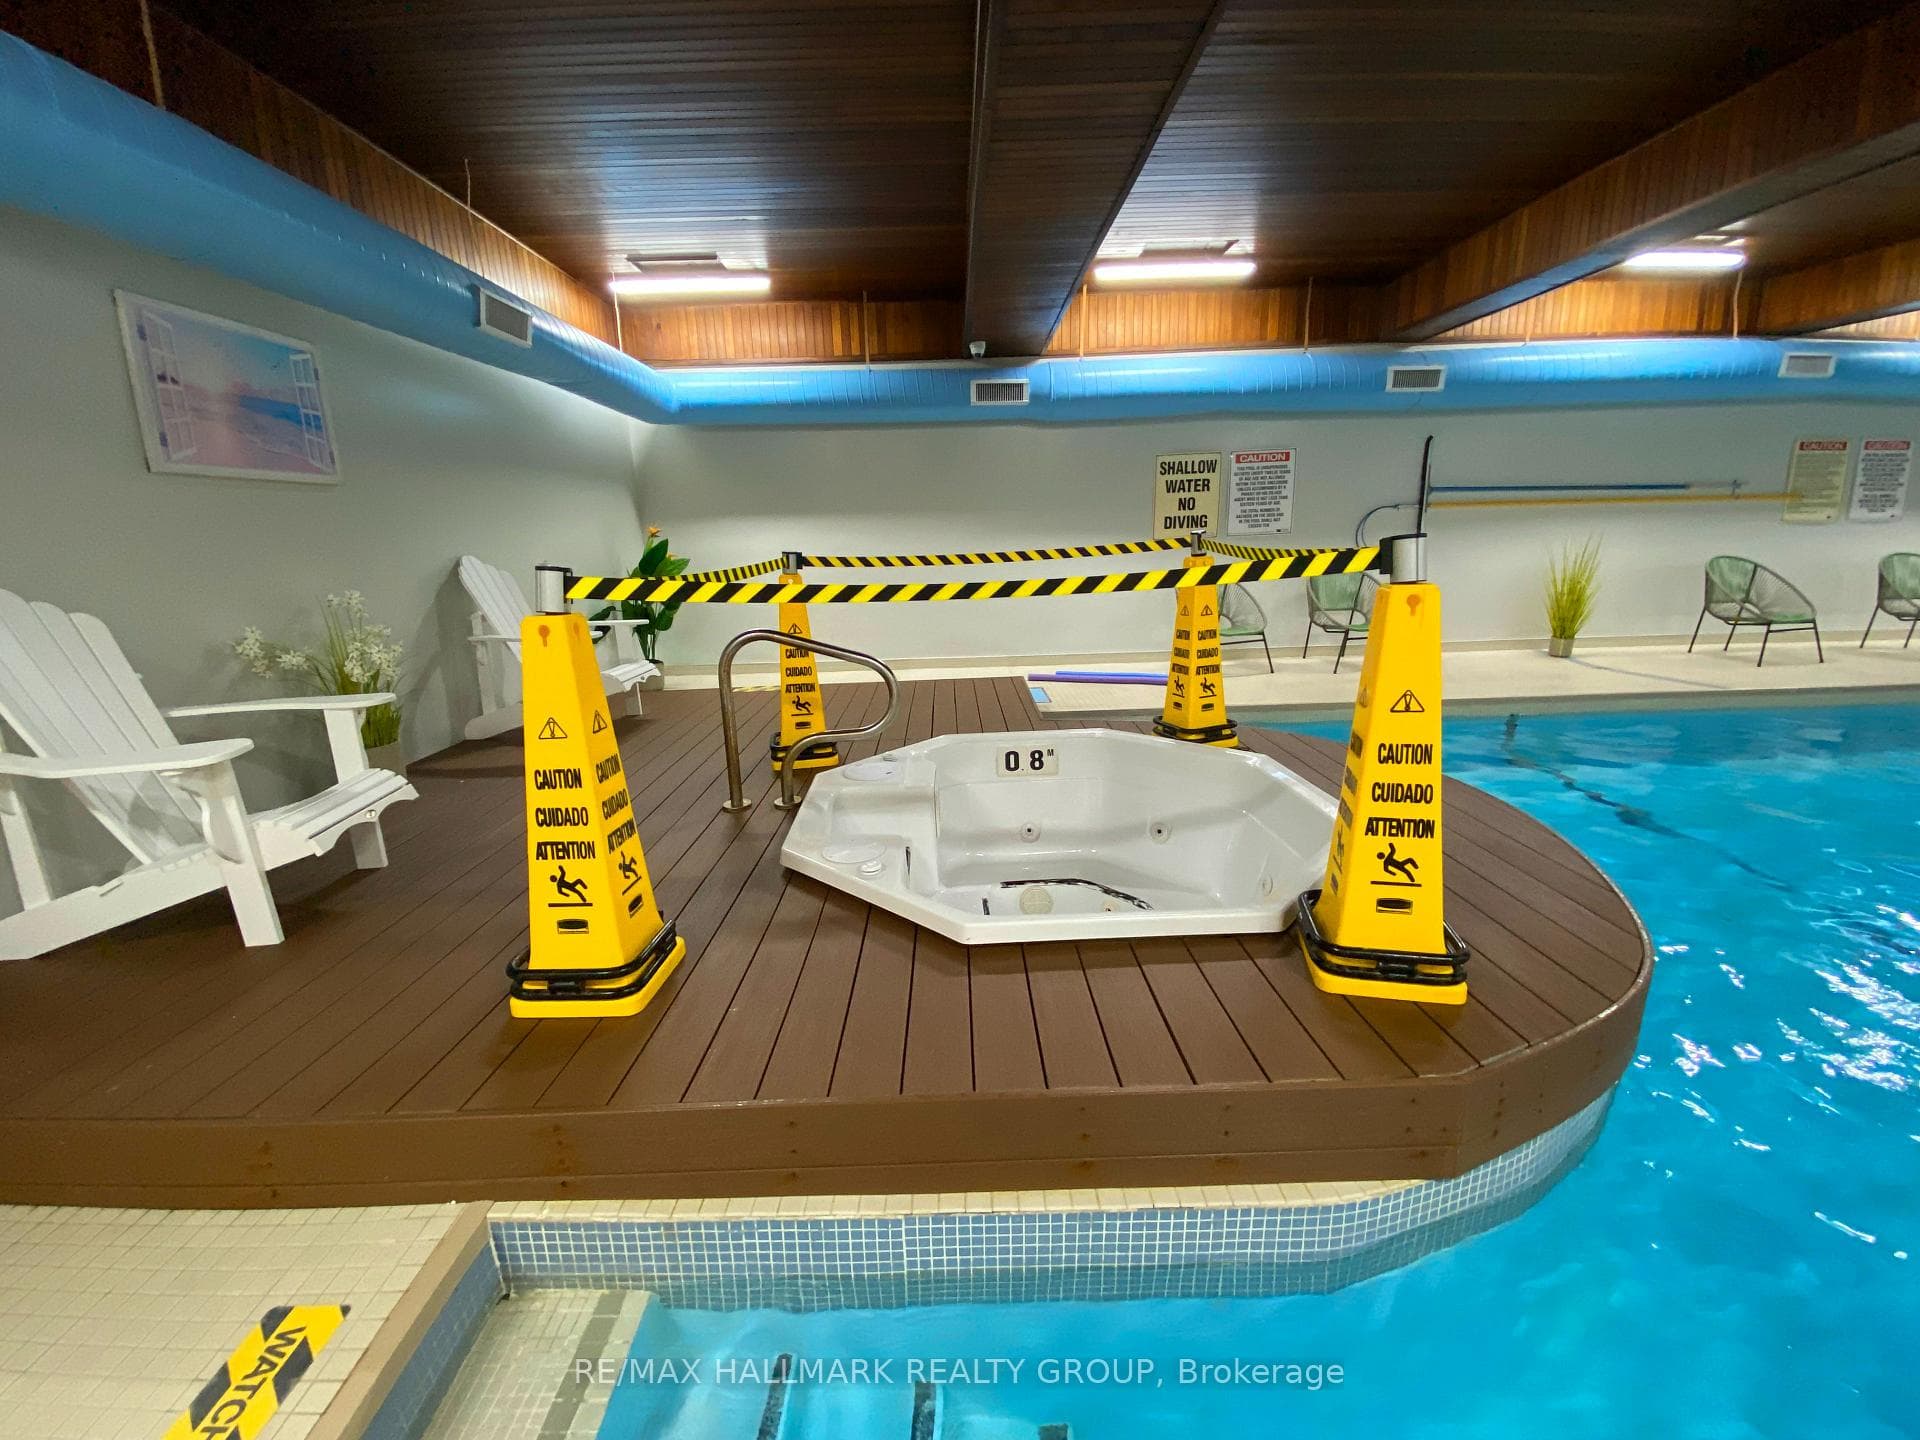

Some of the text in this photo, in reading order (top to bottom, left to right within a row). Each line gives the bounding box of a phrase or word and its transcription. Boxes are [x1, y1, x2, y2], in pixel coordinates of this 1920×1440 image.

[1159, 459, 1217, 475] SHALLOW
[1240, 452, 1286, 462] CAUTION
[1165, 478, 1211, 493] WATER
[1178, 497, 1196, 511] NO
[1164, 514, 1208, 530] DIVING
[1196, 647, 1219, 659] CUIDADO
[785, 666, 812, 677] CUIDADO
[785, 683, 816, 693] ATTENTION
[1377, 743, 1433, 765] CAUTION
[596, 753, 621, 784] CAUTION
[534, 768, 582, 790] CAUTION
[1371, 782, 1434, 804] CUIDADO
[602, 788, 628, 820] CUIDADO
[535, 806, 588, 827] CUIDADO
[607, 817, 637, 854] ATTENTION
[1365, 816, 1435, 839] ATTENTION
[536, 840, 596, 860] ATTENTION
